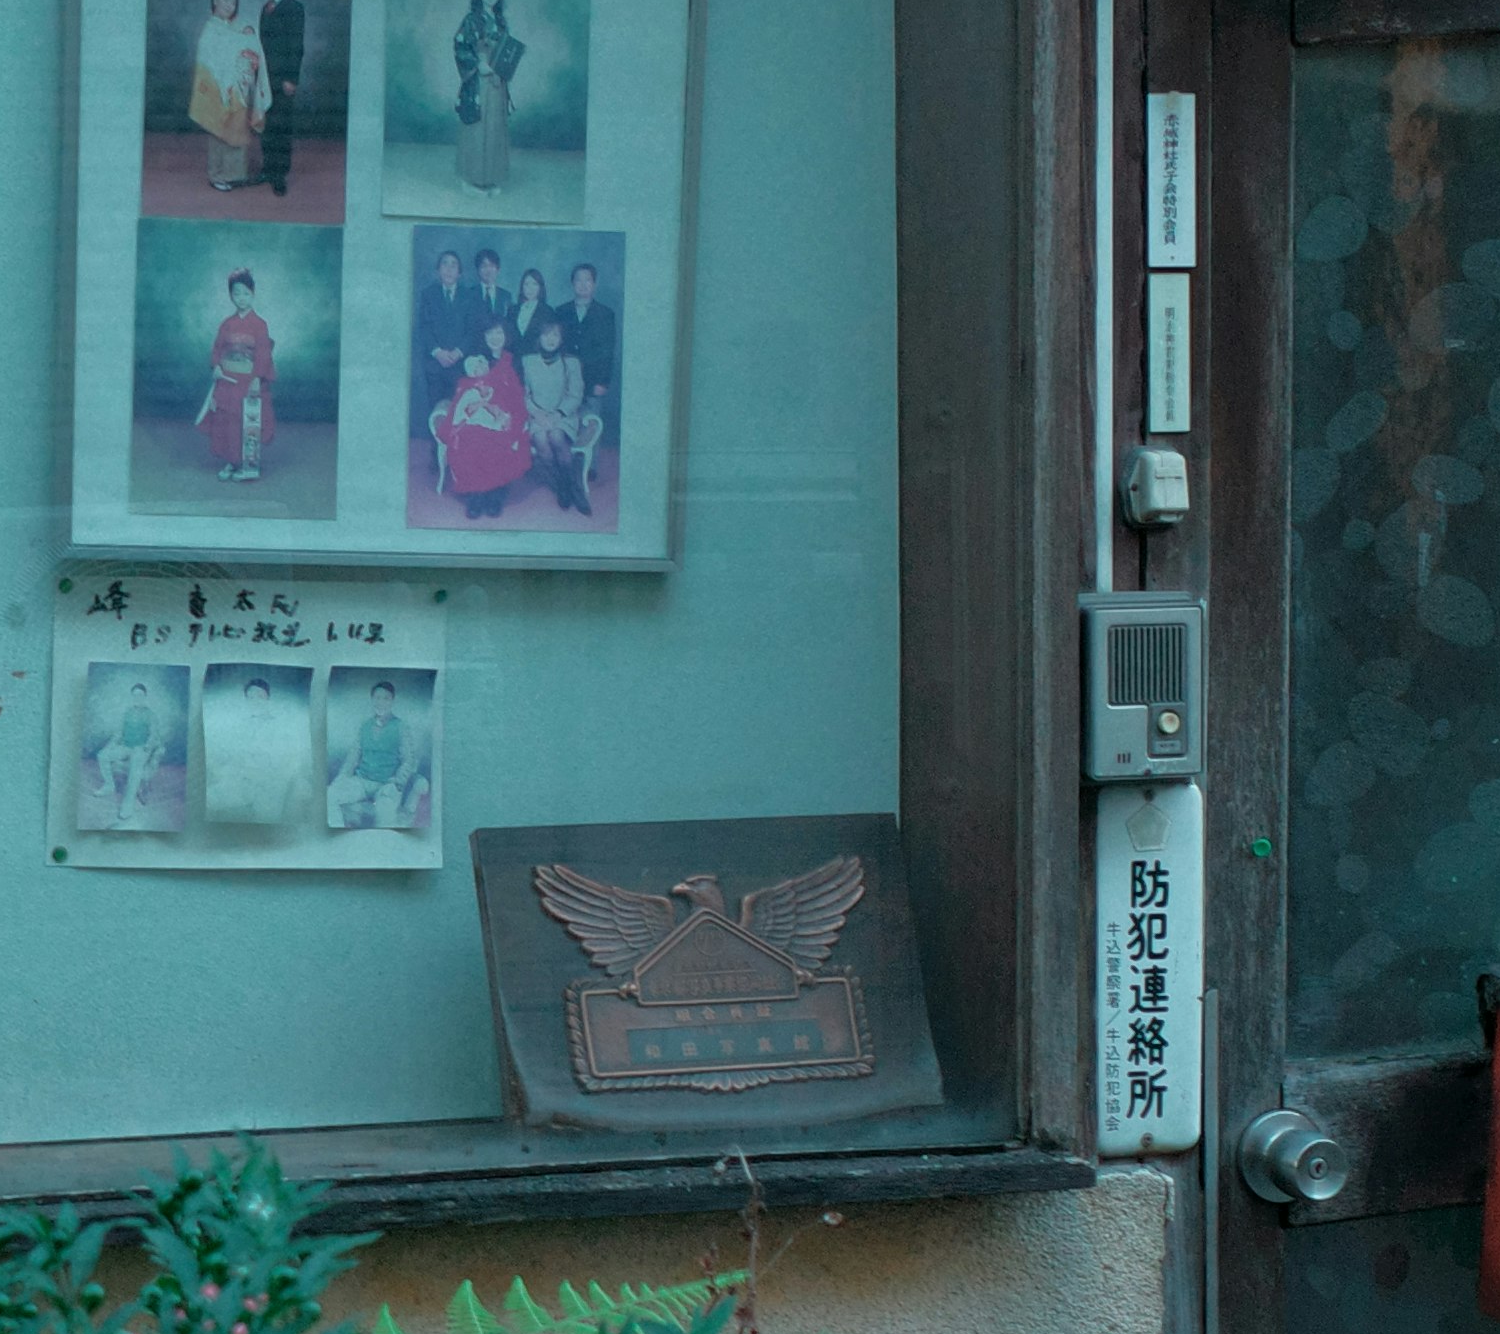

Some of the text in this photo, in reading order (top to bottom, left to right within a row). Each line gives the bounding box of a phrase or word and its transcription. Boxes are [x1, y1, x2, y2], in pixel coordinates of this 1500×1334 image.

[1124, 859, 1171, 1120] 防犯連絡所
